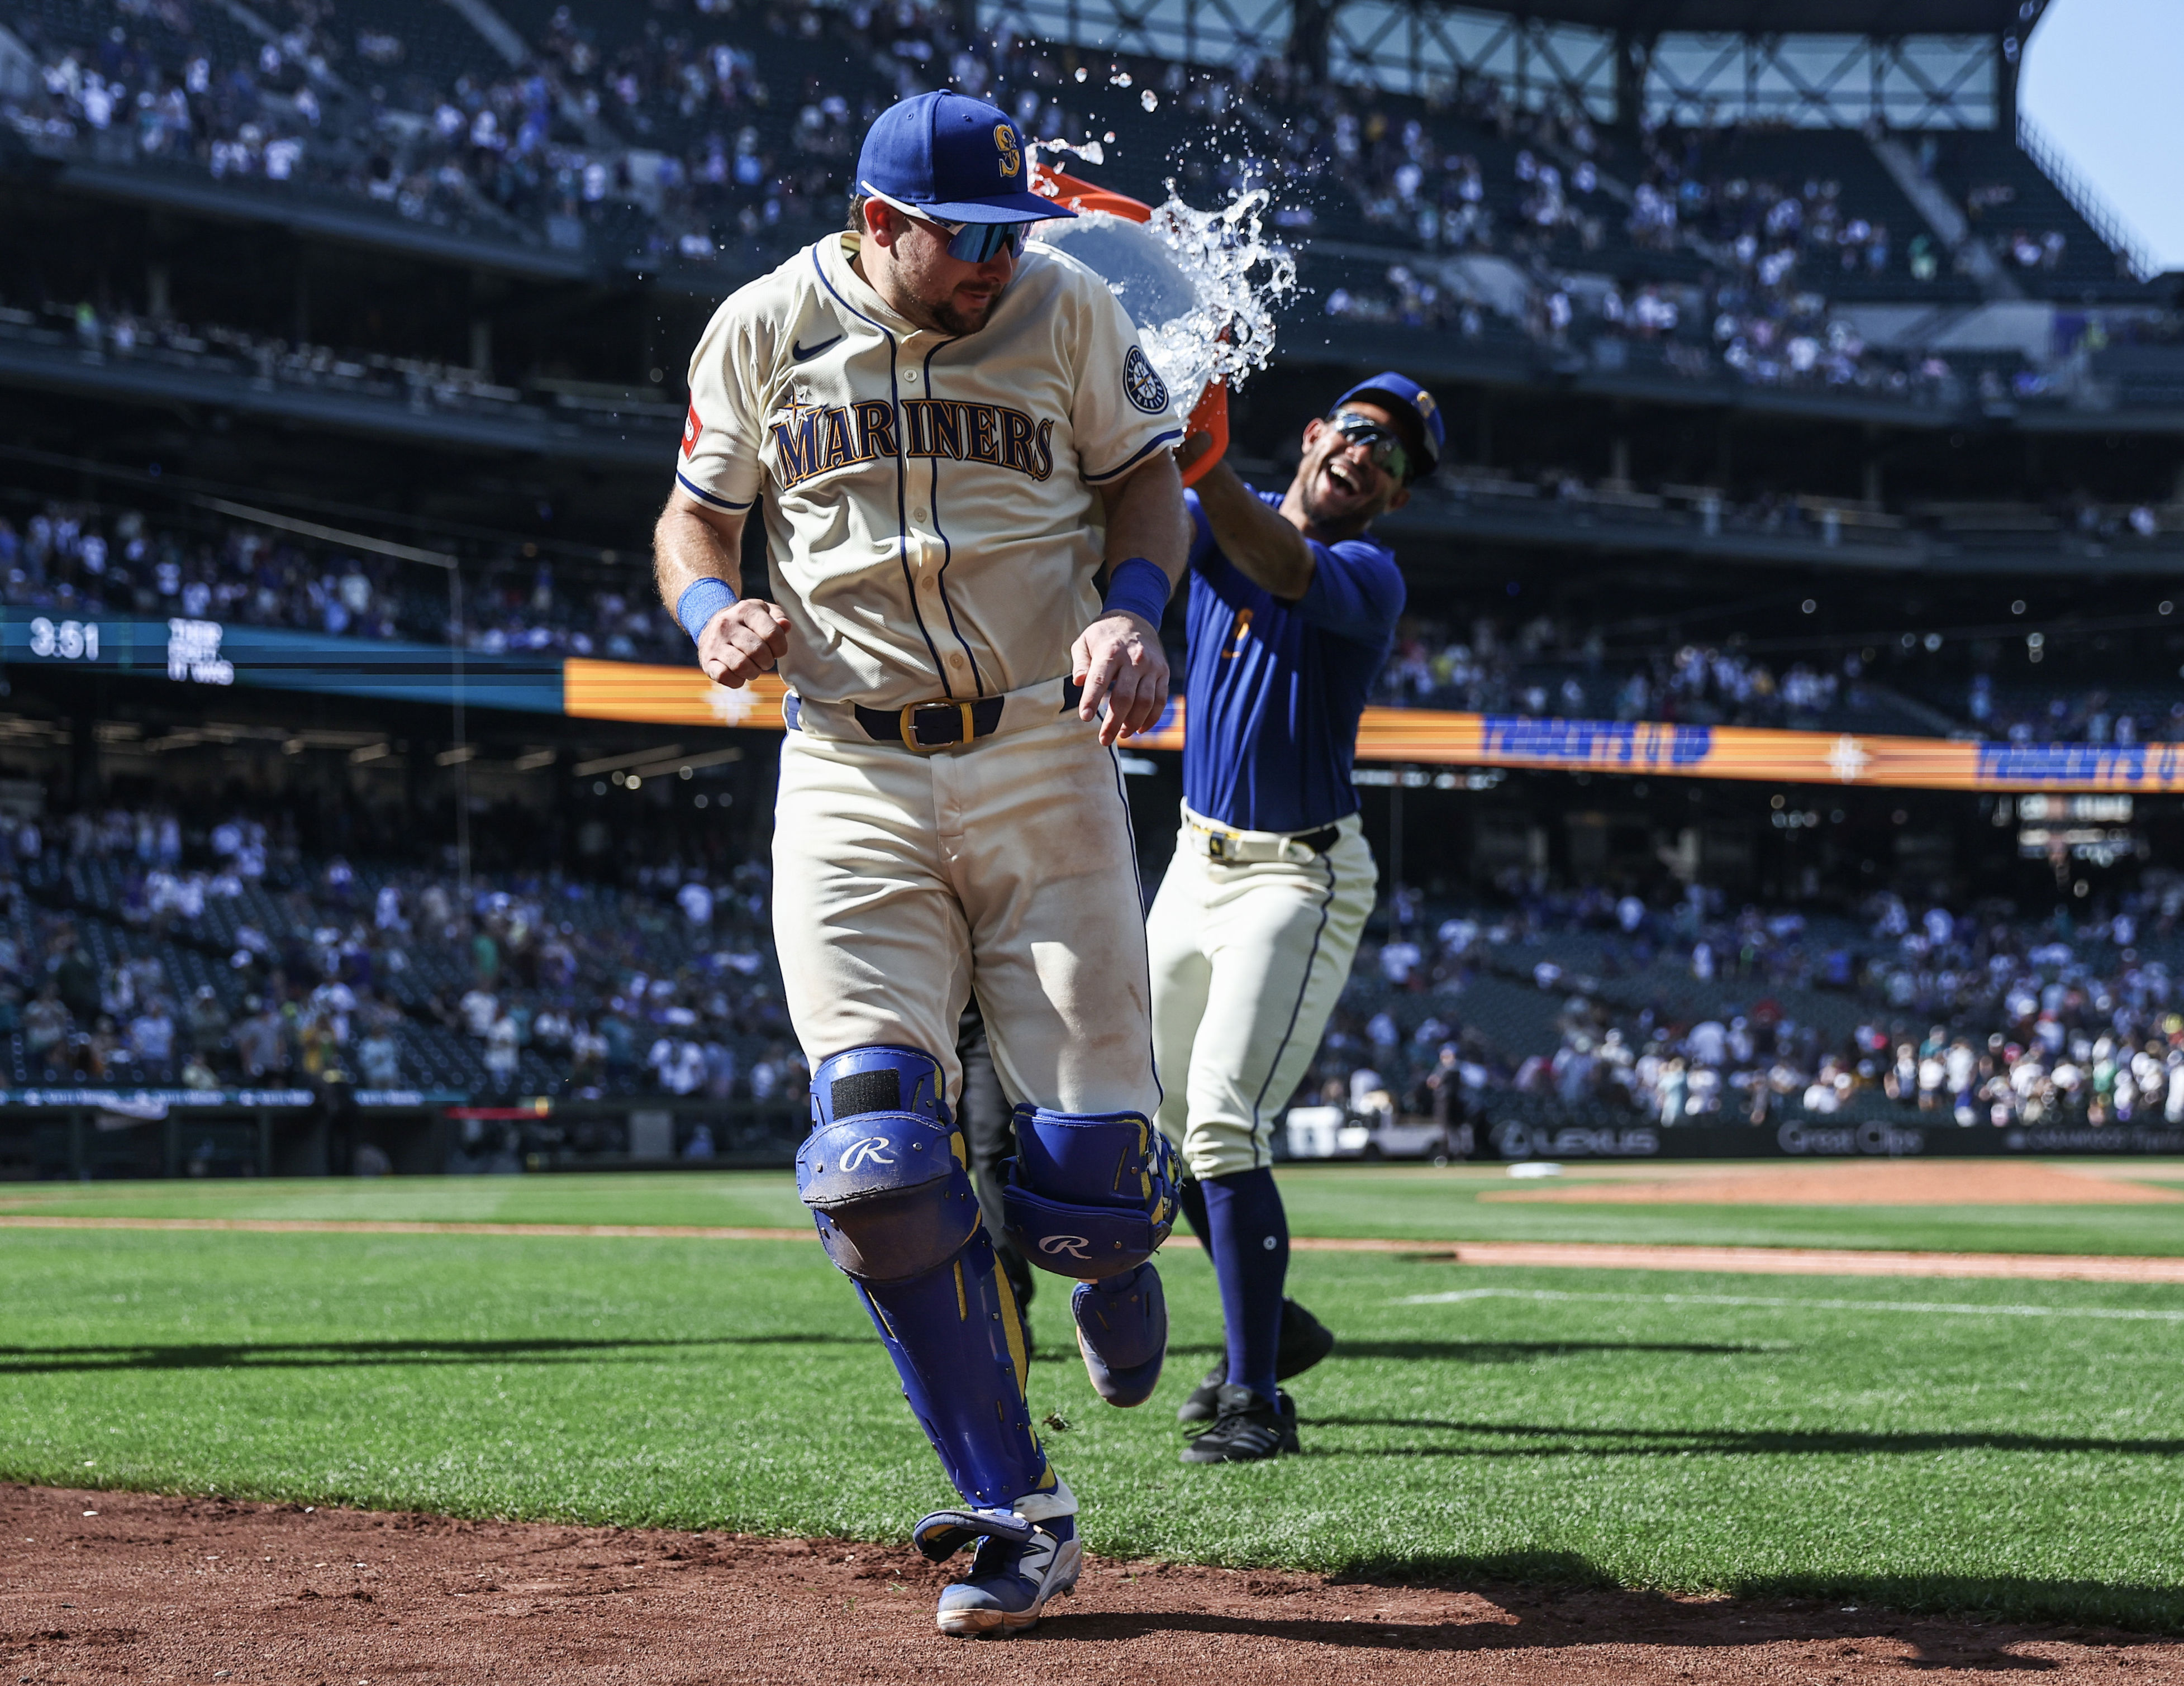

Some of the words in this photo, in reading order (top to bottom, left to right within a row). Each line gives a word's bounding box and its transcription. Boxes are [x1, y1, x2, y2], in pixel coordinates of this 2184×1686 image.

[993, 123, 1020, 178] S
[769, 399, 1055, 492] MARINERS
[30, 616, 99, 661] 3:51
[1531, 1127, 1659, 1155] LEXUS
